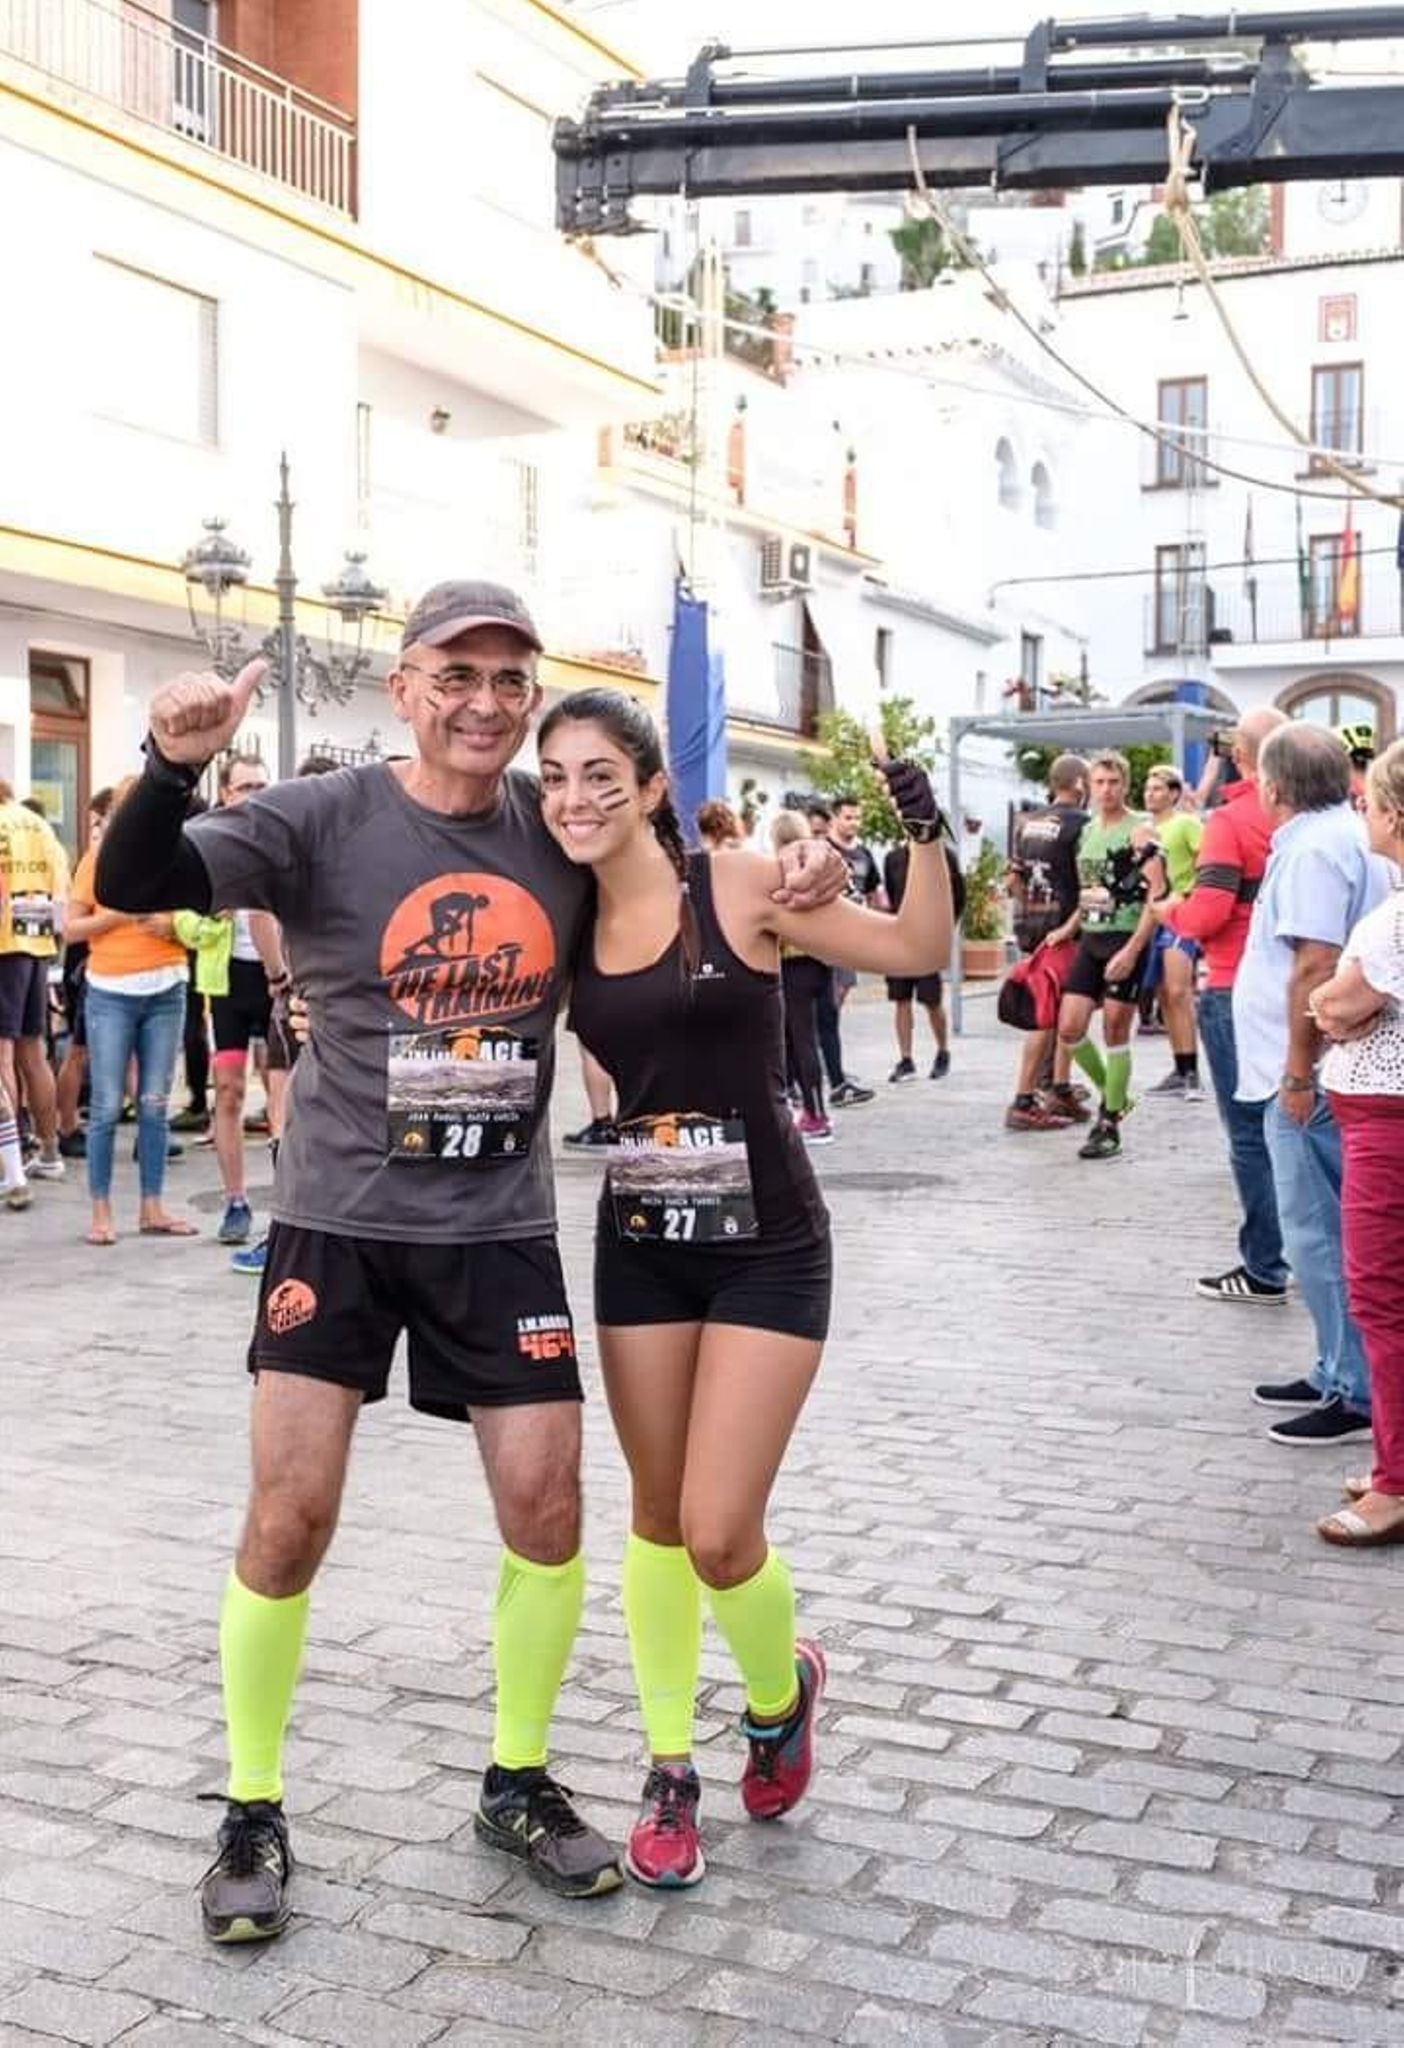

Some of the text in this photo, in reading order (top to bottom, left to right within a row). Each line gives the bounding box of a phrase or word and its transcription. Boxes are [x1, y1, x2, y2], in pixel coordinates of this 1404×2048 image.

[389, 947, 522, 1001] THE LAST
[441, 1123, 484, 1158] 28
[663, 1208, 697, 1241] 27
